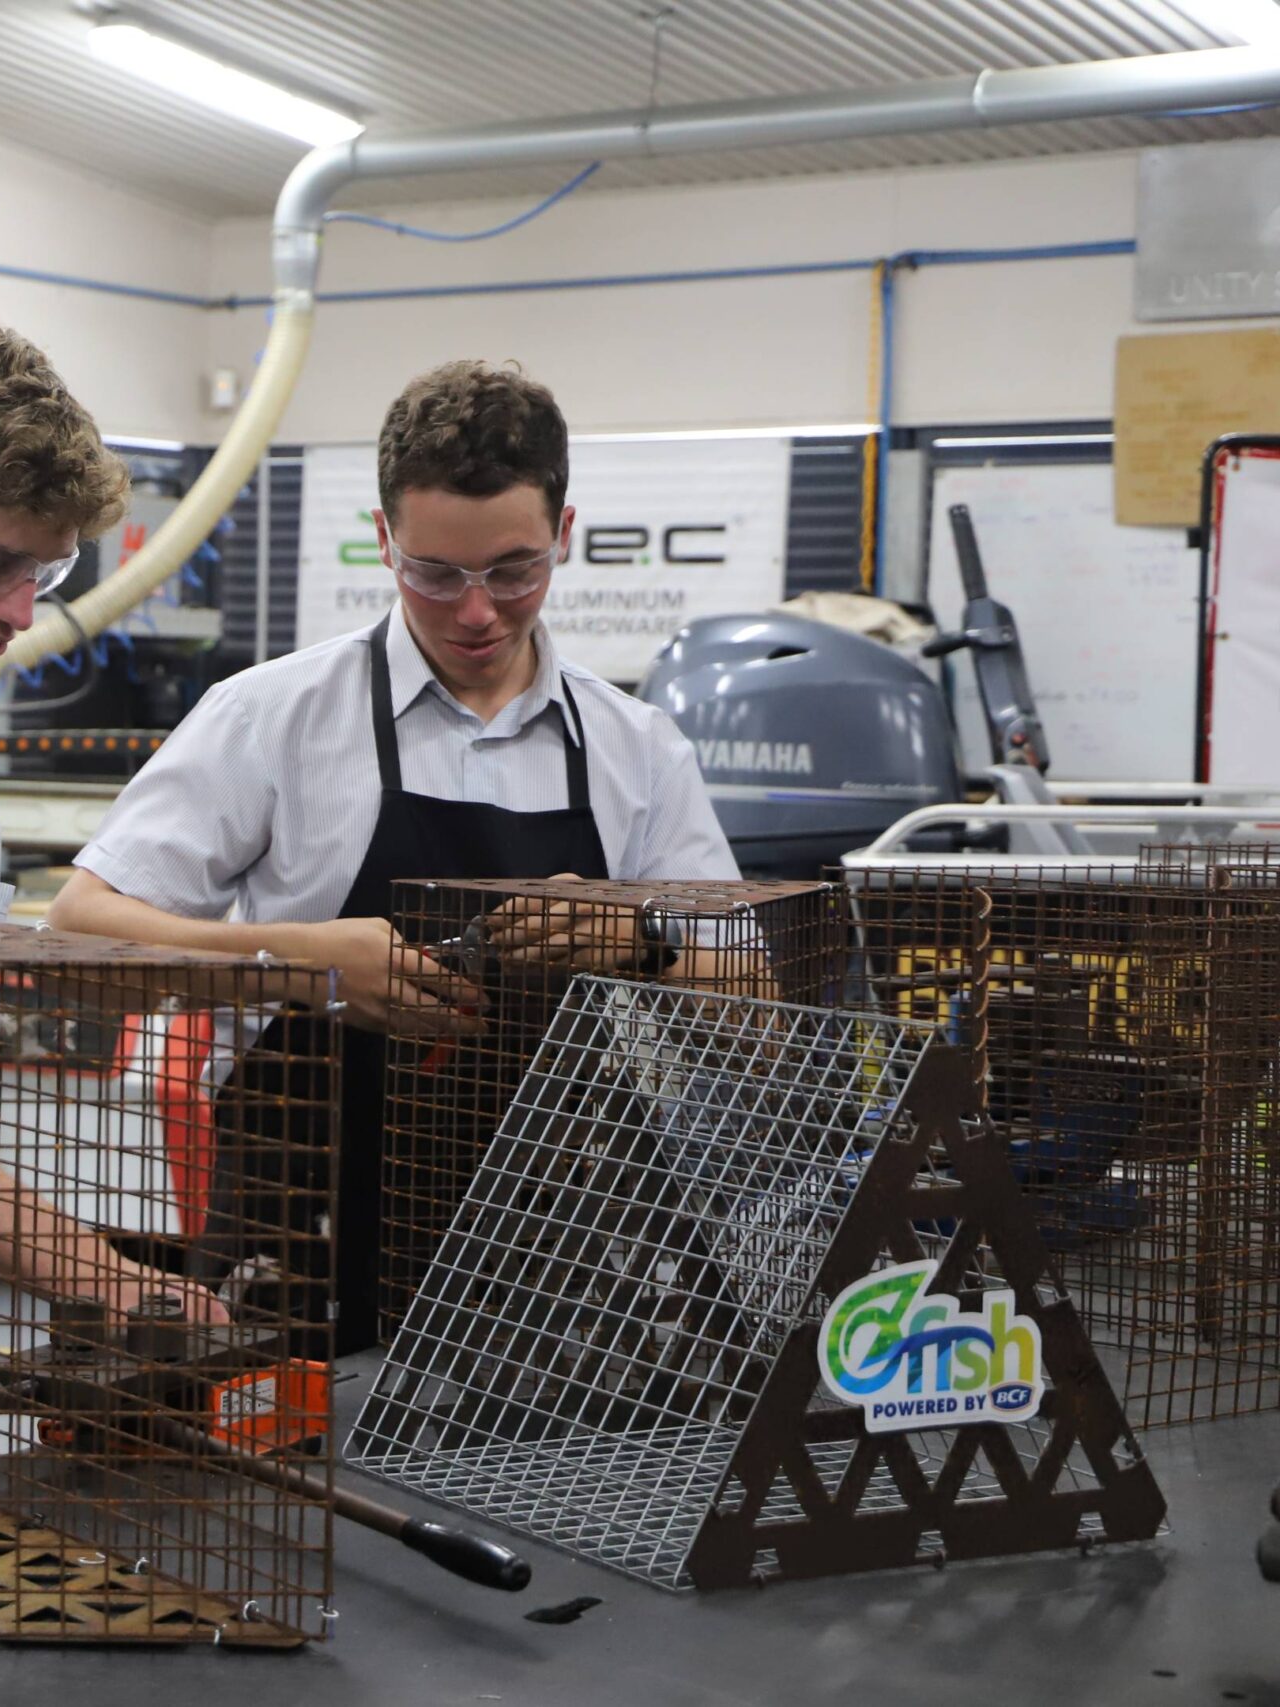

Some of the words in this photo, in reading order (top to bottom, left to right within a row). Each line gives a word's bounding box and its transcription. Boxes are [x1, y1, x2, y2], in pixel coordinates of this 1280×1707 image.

[1169, 270, 1264, 304] UNITY
[544, 588, 686, 610] LUMINIUM
[697, 738, 813, 775] YAMAHA
[873, 1397, 958, 1419] POWERED
[964, 1394, 987, 1412] BY
[996, 1388, 1028, 1404] BCF
